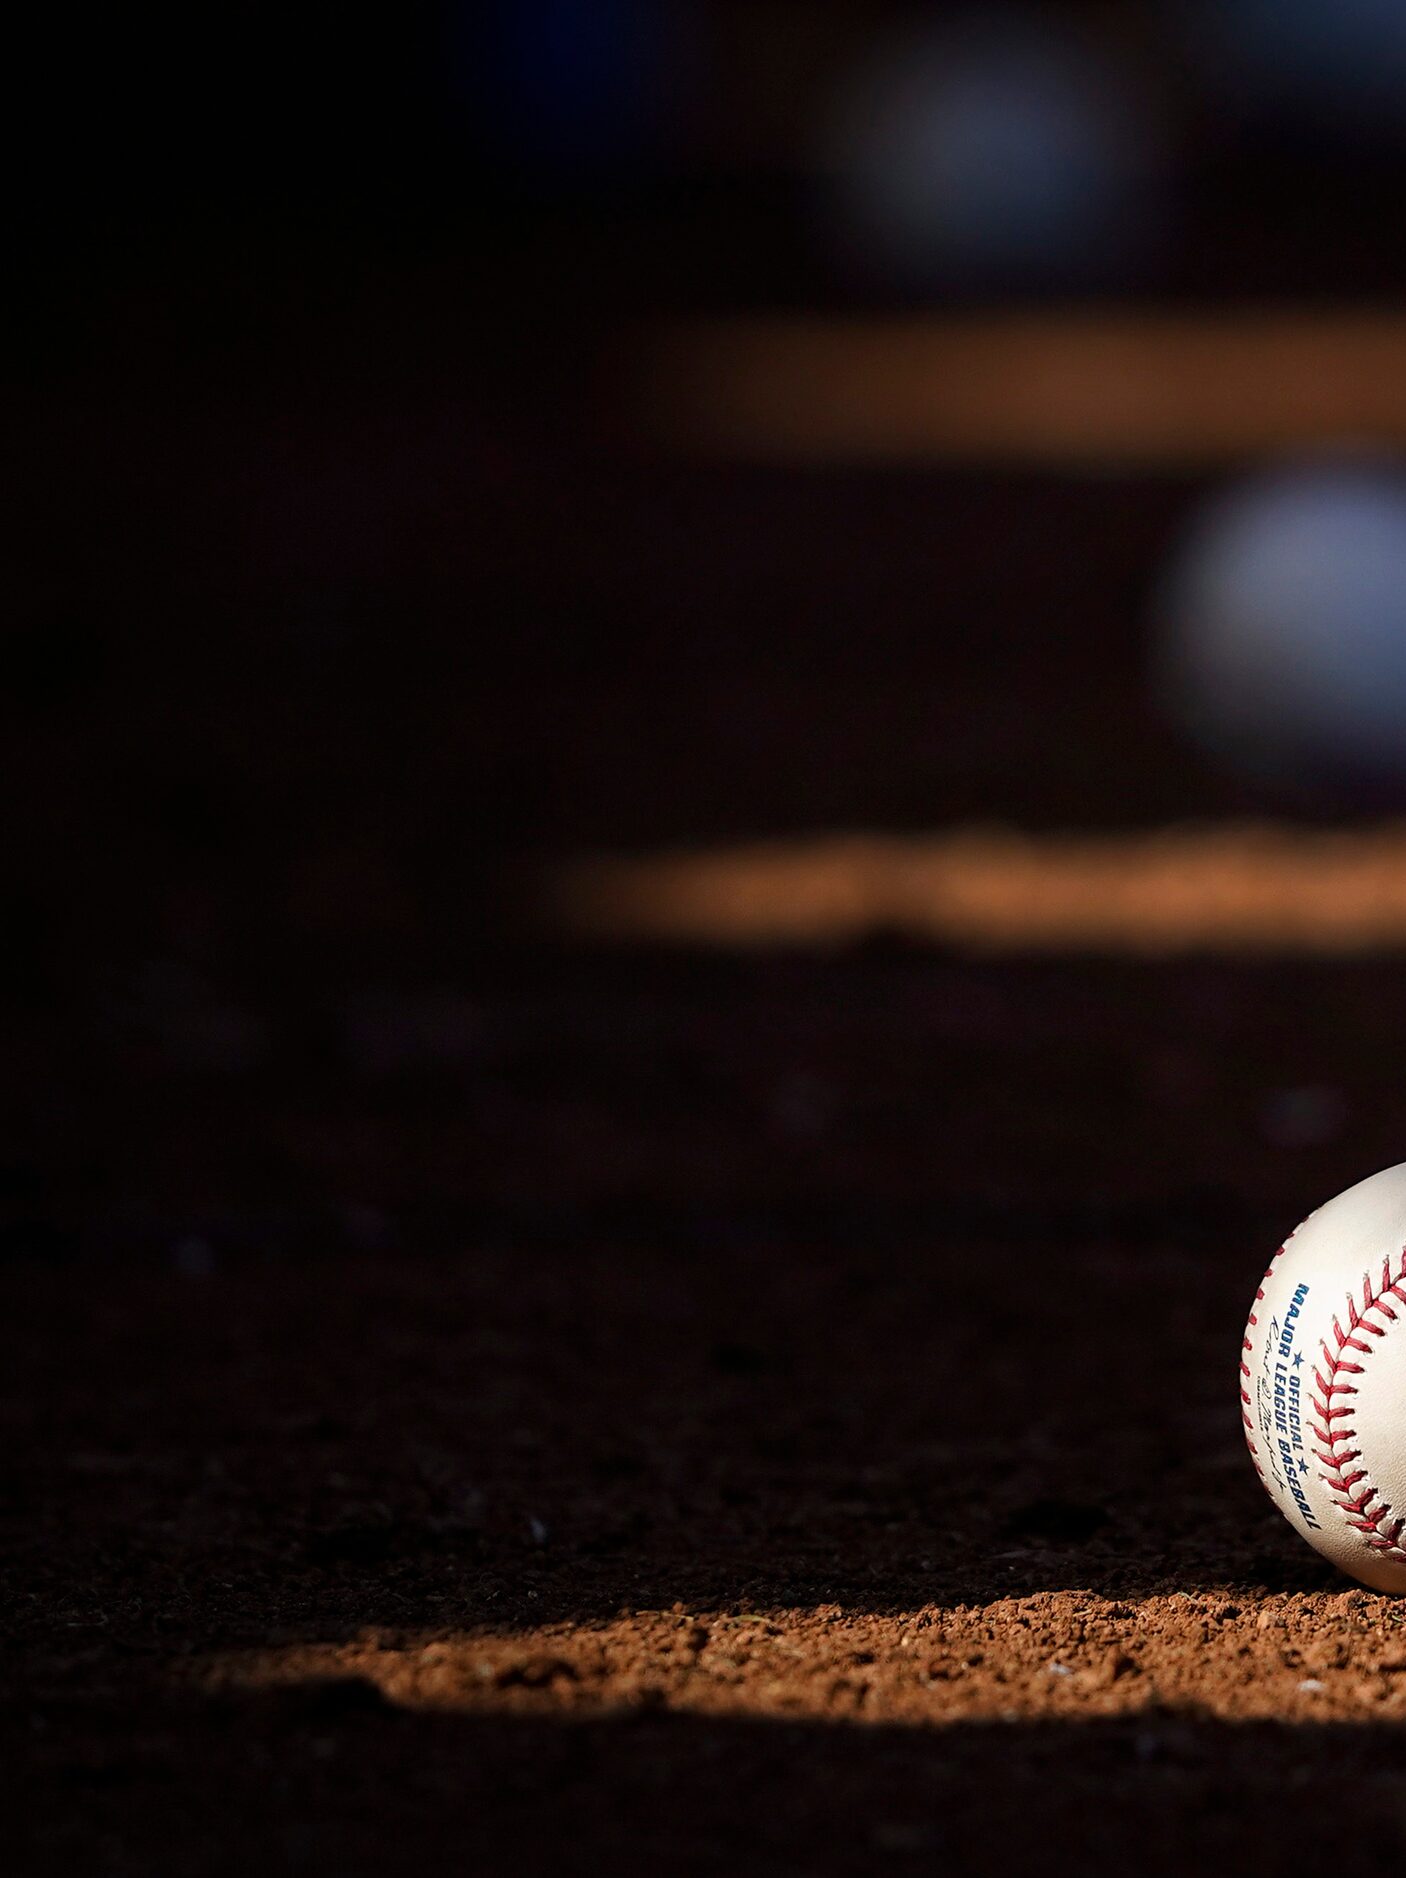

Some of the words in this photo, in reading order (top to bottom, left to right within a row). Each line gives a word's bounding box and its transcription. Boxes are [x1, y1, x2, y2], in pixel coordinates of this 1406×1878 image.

[1278, 1283, 1310, 1358] MAJOR
[1273, 1363, 1288, 1435] LEAGUE
[1289, 1375, 1304, 1451] OFFICIAL
[1275, 1438, 1322, 1531] BASEBALL
